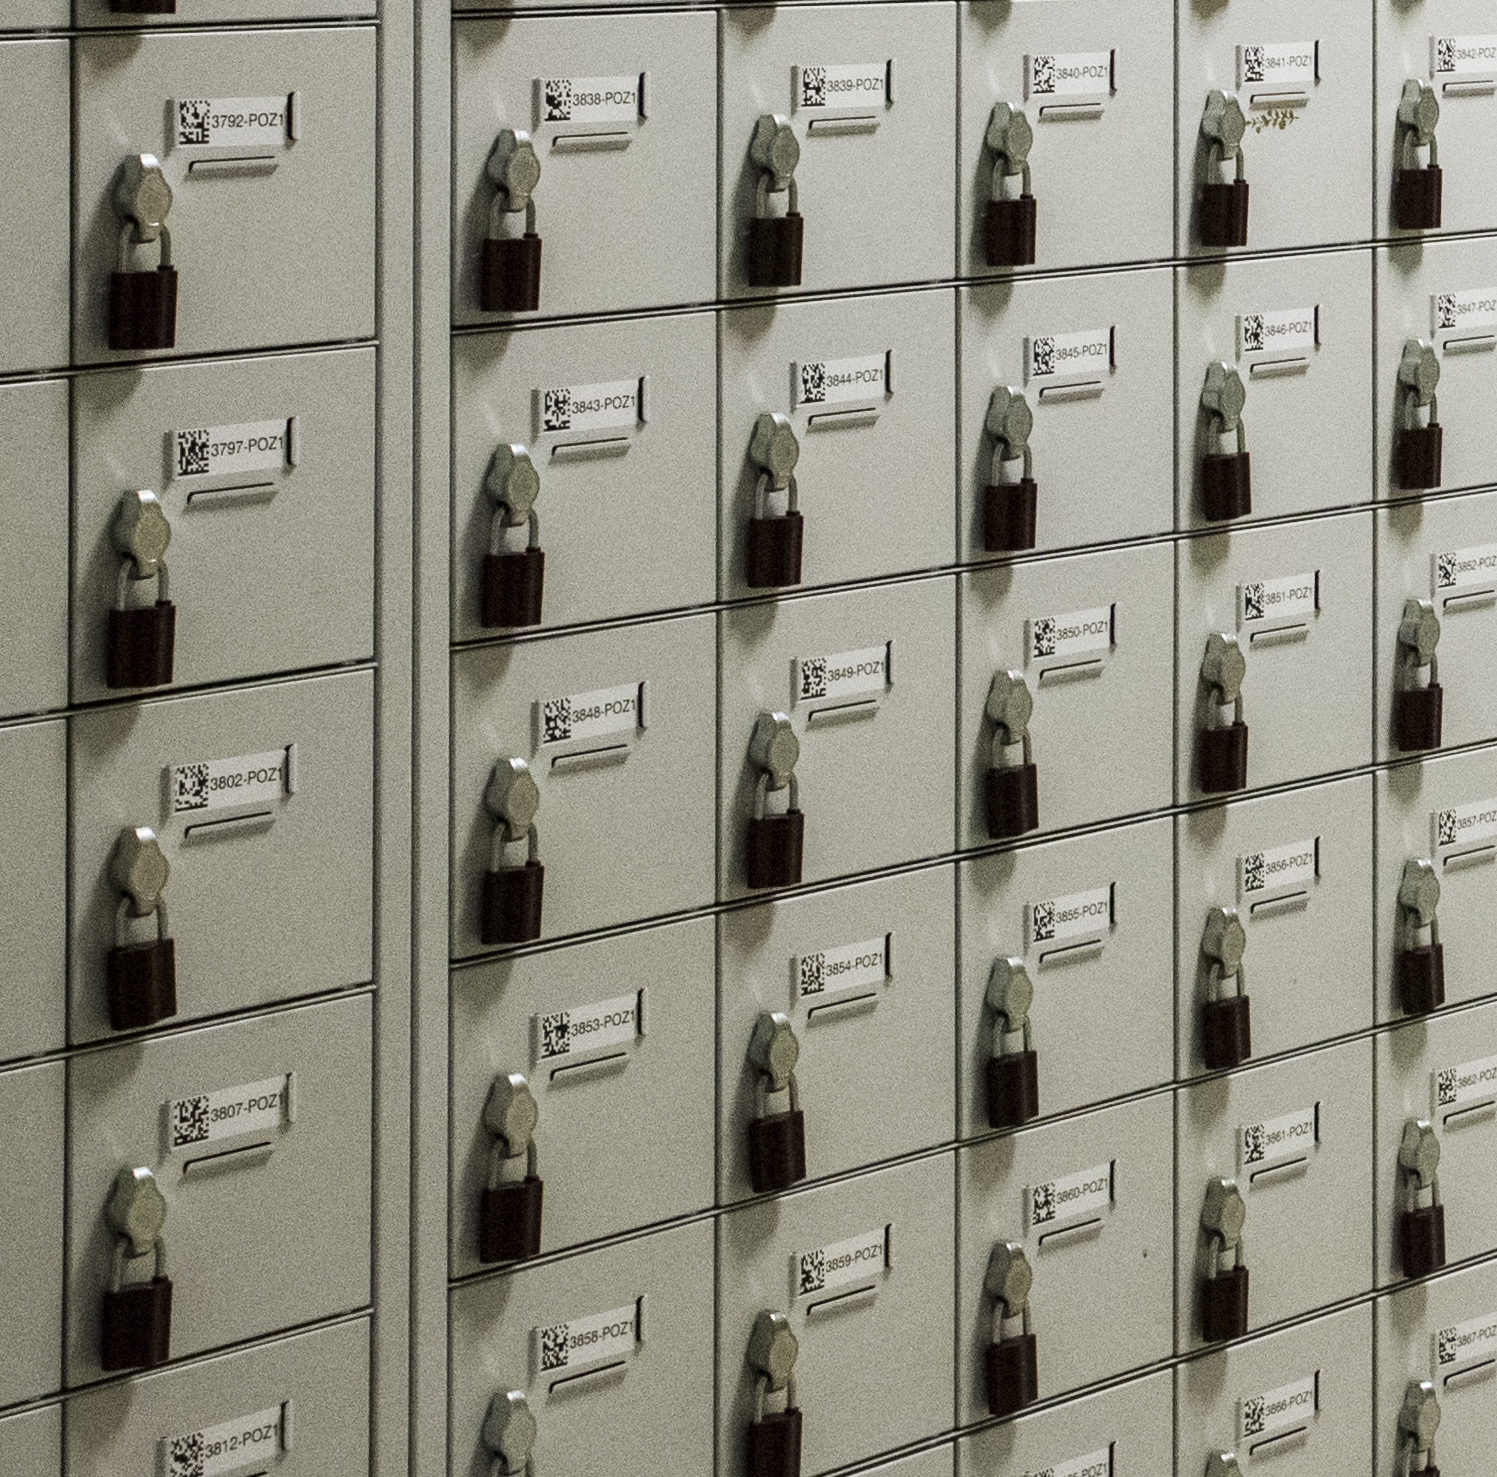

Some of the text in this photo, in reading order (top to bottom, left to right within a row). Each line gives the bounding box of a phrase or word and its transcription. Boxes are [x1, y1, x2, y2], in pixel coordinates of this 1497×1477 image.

[1265, 56, 1312, 68] 3841-POZ1
[1057, 67, 1108, 79] 3840-POZ1
[827, 79, 883, 93] 3839-POZ1
[572, 91, 636, 106] 3838-POZ1
[212, 112, 284, 128] 3792-POZ1
[1265, 322, 1312, 337] 3846-POZ1
[1056, 344, 1107, 360] 3845-POZ1
[826, 371, 883, 388] 3844-POZ1
[572, 395, 635, 414] 3843-POZ1
[211, 435, 283, 457] 3797-POZ1
[1265, 587, 1312, 604] 3851-POZ1
[1057, 622, 1108, 641] 3850-POZ1
[828, 661, 884, 682] 3849-POZ1
[572, 699, 636, 723] 3848-POZ1
[211, 767, 283, 791] 3802-POZ1
[1266, 853, 1313, 874] 3856-POZ1
[1056, 897, 1108, 923] 3855-POZ1
[826, 954, 883, 977] 3854-POZ1
[571, 1009, 635, 1036] 3853-POZ1
[210, 1093, 282, 1121] 3807-POZ1
[1265, 1121, 1313, 1145] 3861-POZ1
[1056, 1178, 1108, 1204] 3860-POZ1
[826, 1244, 883, 1271] 3859-POZ1
[570, 1321, 634, 1350] 3858-POZ1
[1265, 1390, 1313, 1417] 3866-POZ1
[206, 1423, 278, 1457] 3812-POZ1
